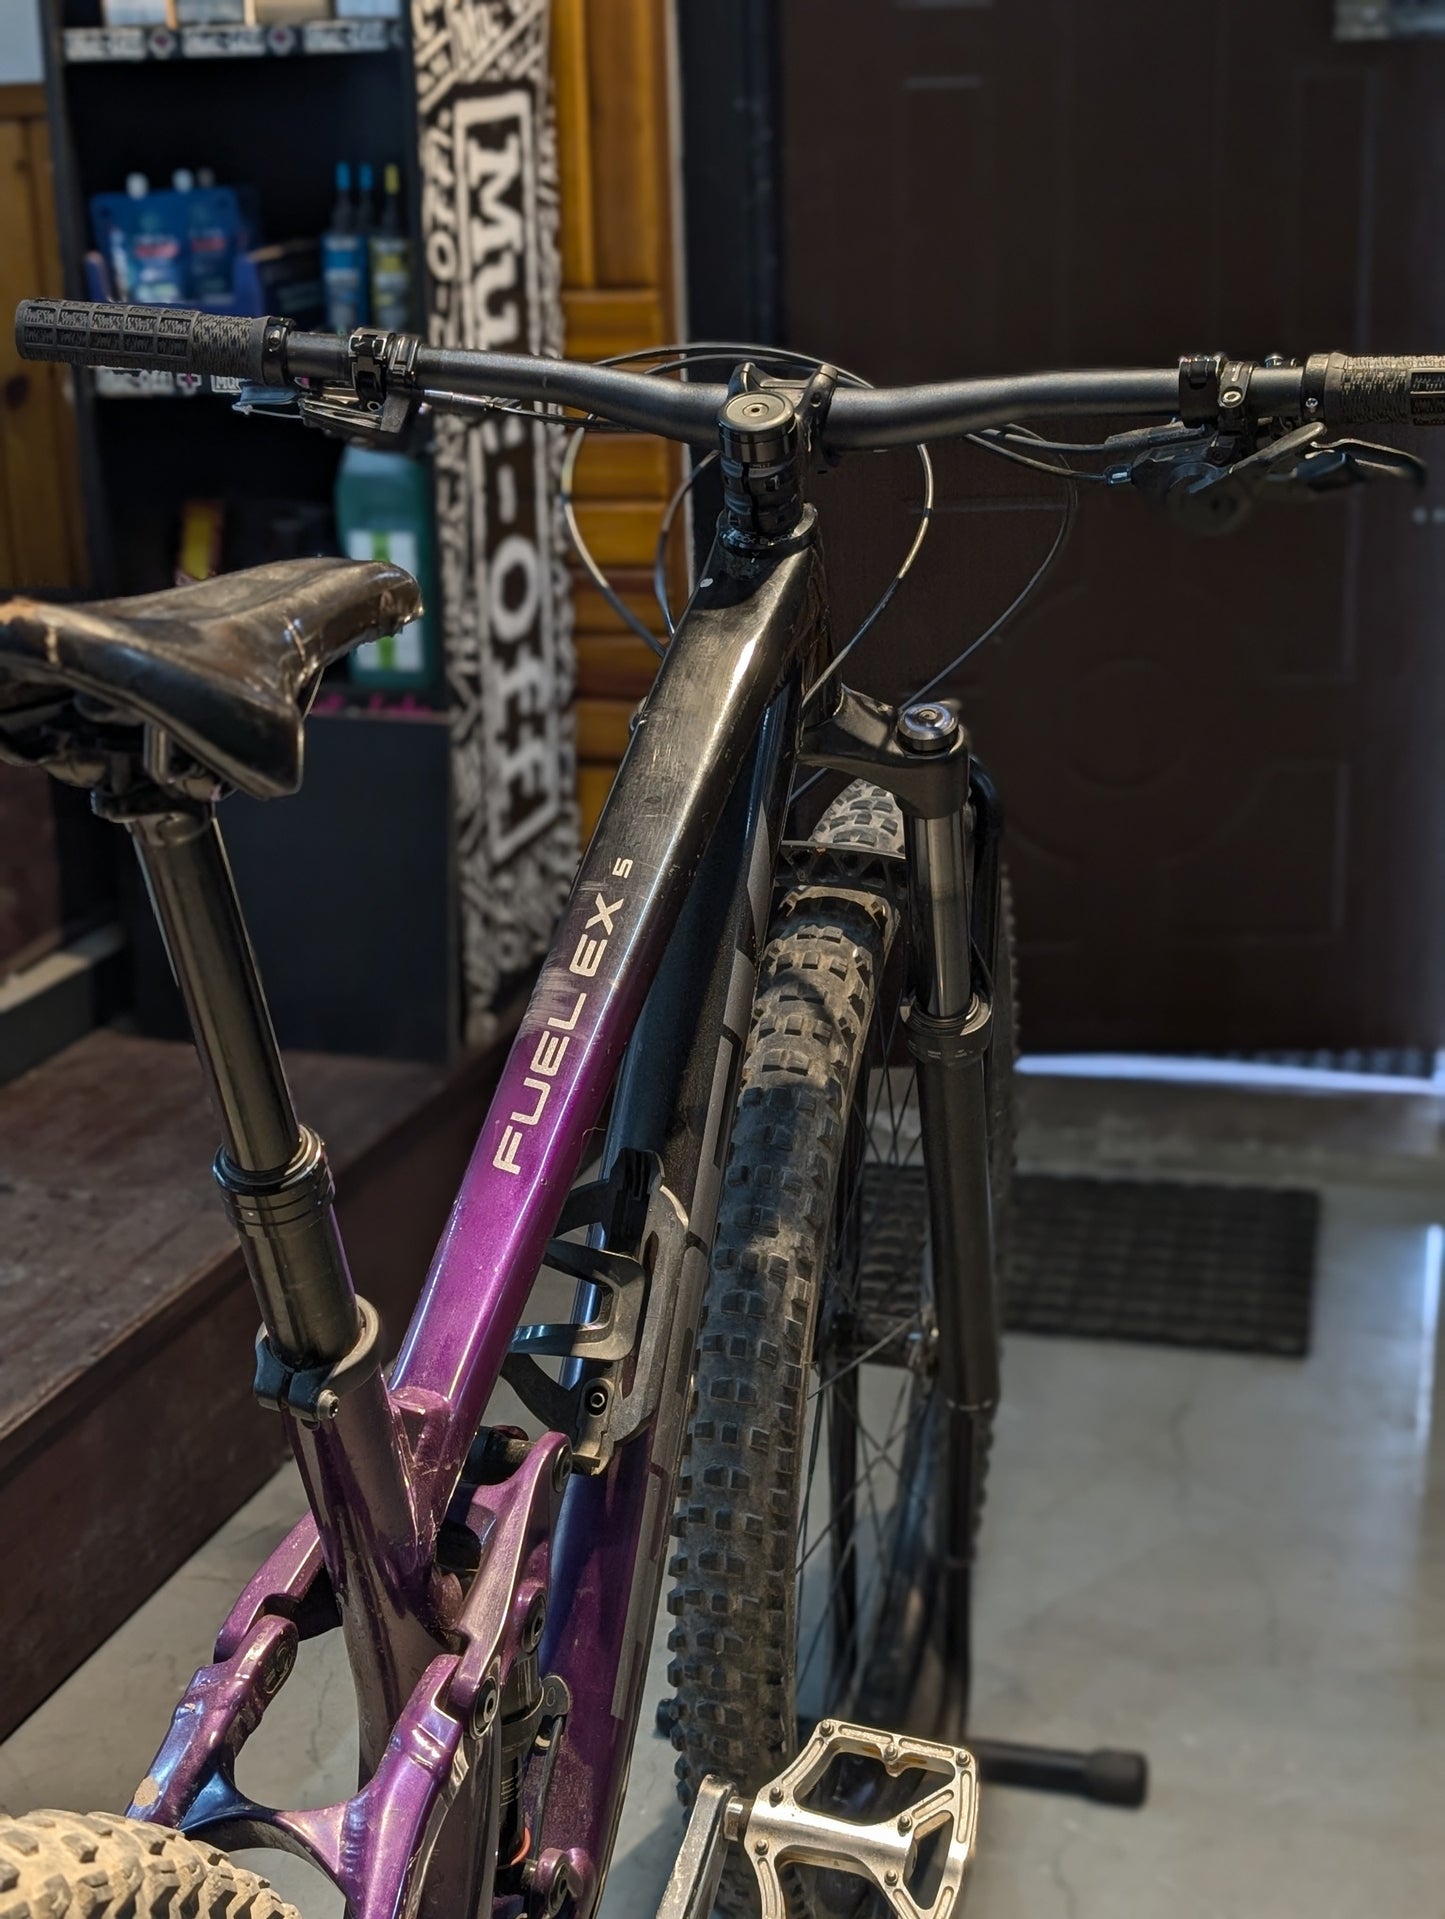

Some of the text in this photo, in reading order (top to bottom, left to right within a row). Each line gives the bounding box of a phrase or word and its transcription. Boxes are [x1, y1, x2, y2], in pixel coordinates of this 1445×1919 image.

[493, 993, 587, 1175] FUEL
[569, 893, 624, 977] EX
[612, 857, 633, 879] 5
